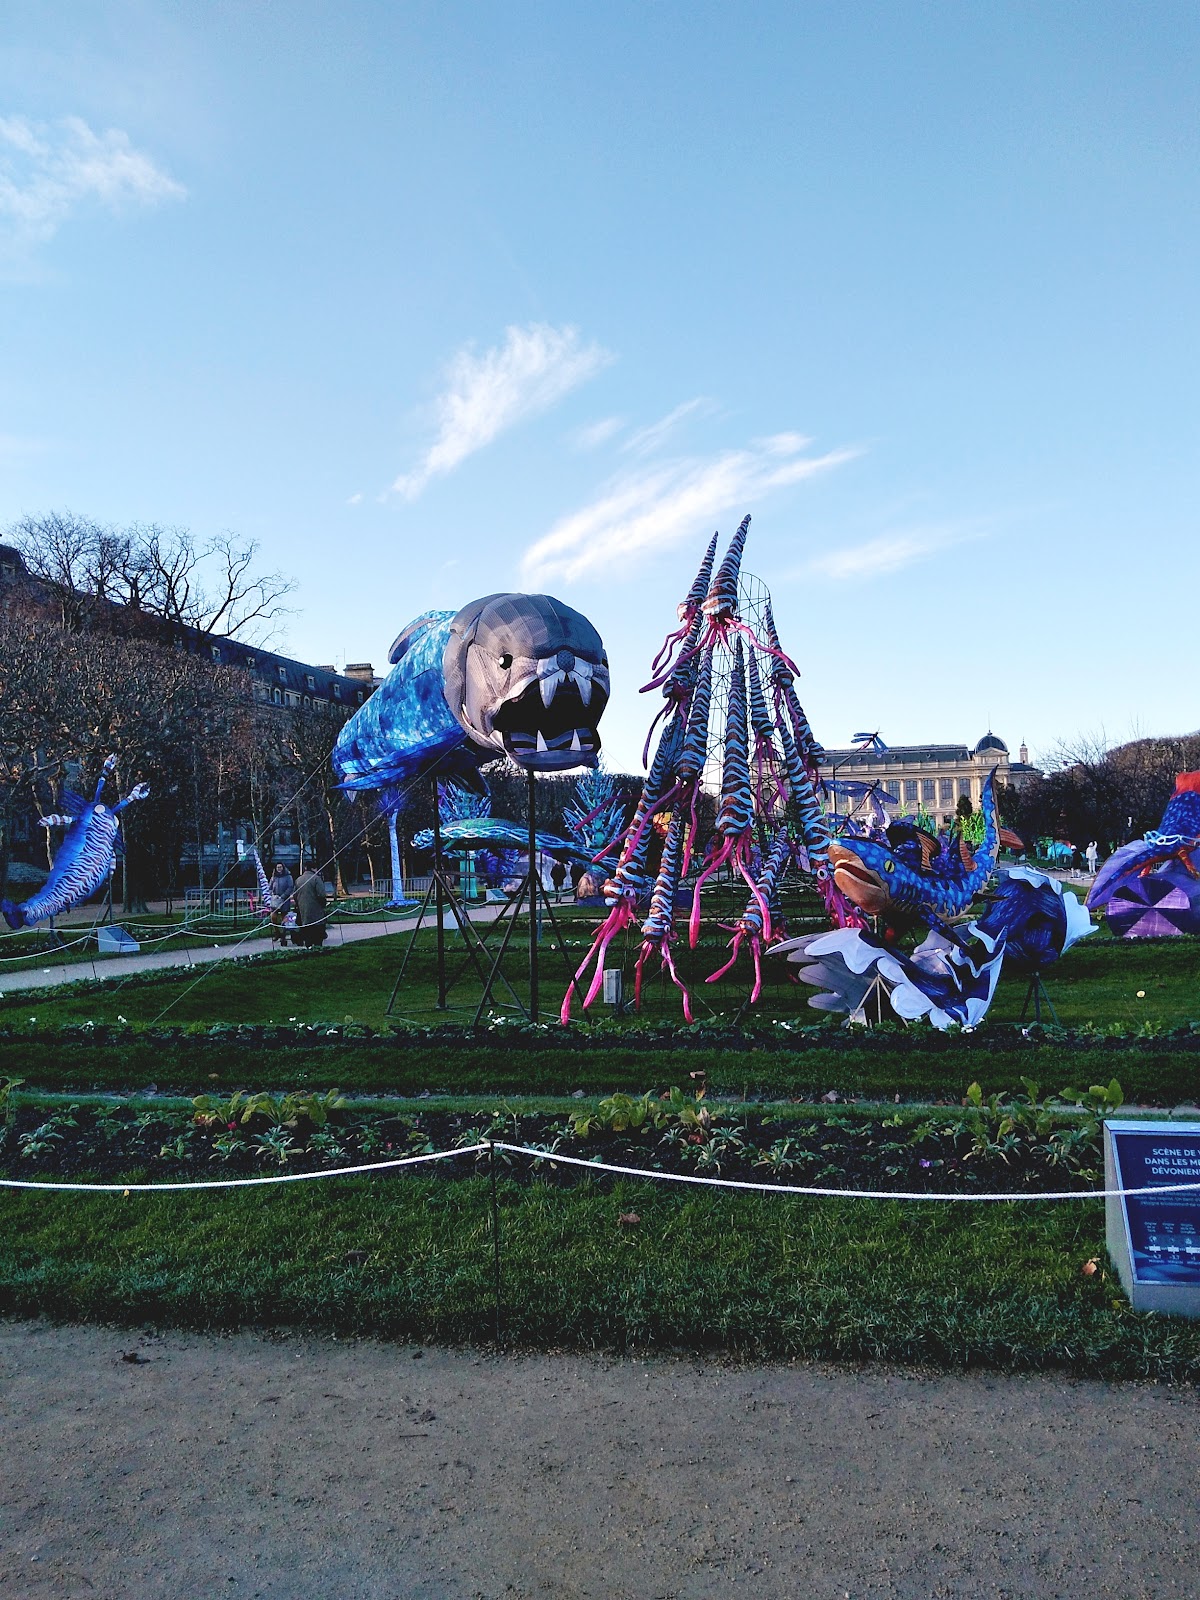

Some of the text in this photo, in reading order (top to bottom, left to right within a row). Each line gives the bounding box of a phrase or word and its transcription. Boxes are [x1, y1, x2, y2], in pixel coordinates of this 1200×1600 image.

[1152, 1147, 1182, 1156] SCÈNE
[1184, 1149, 1196, 1157] DE
[1144, 1157, 1170, 1165] DANS
[1171, 1158, 1188, 1166] LES
[1151, 1166, 1200, 1175] DÉVONIEN
